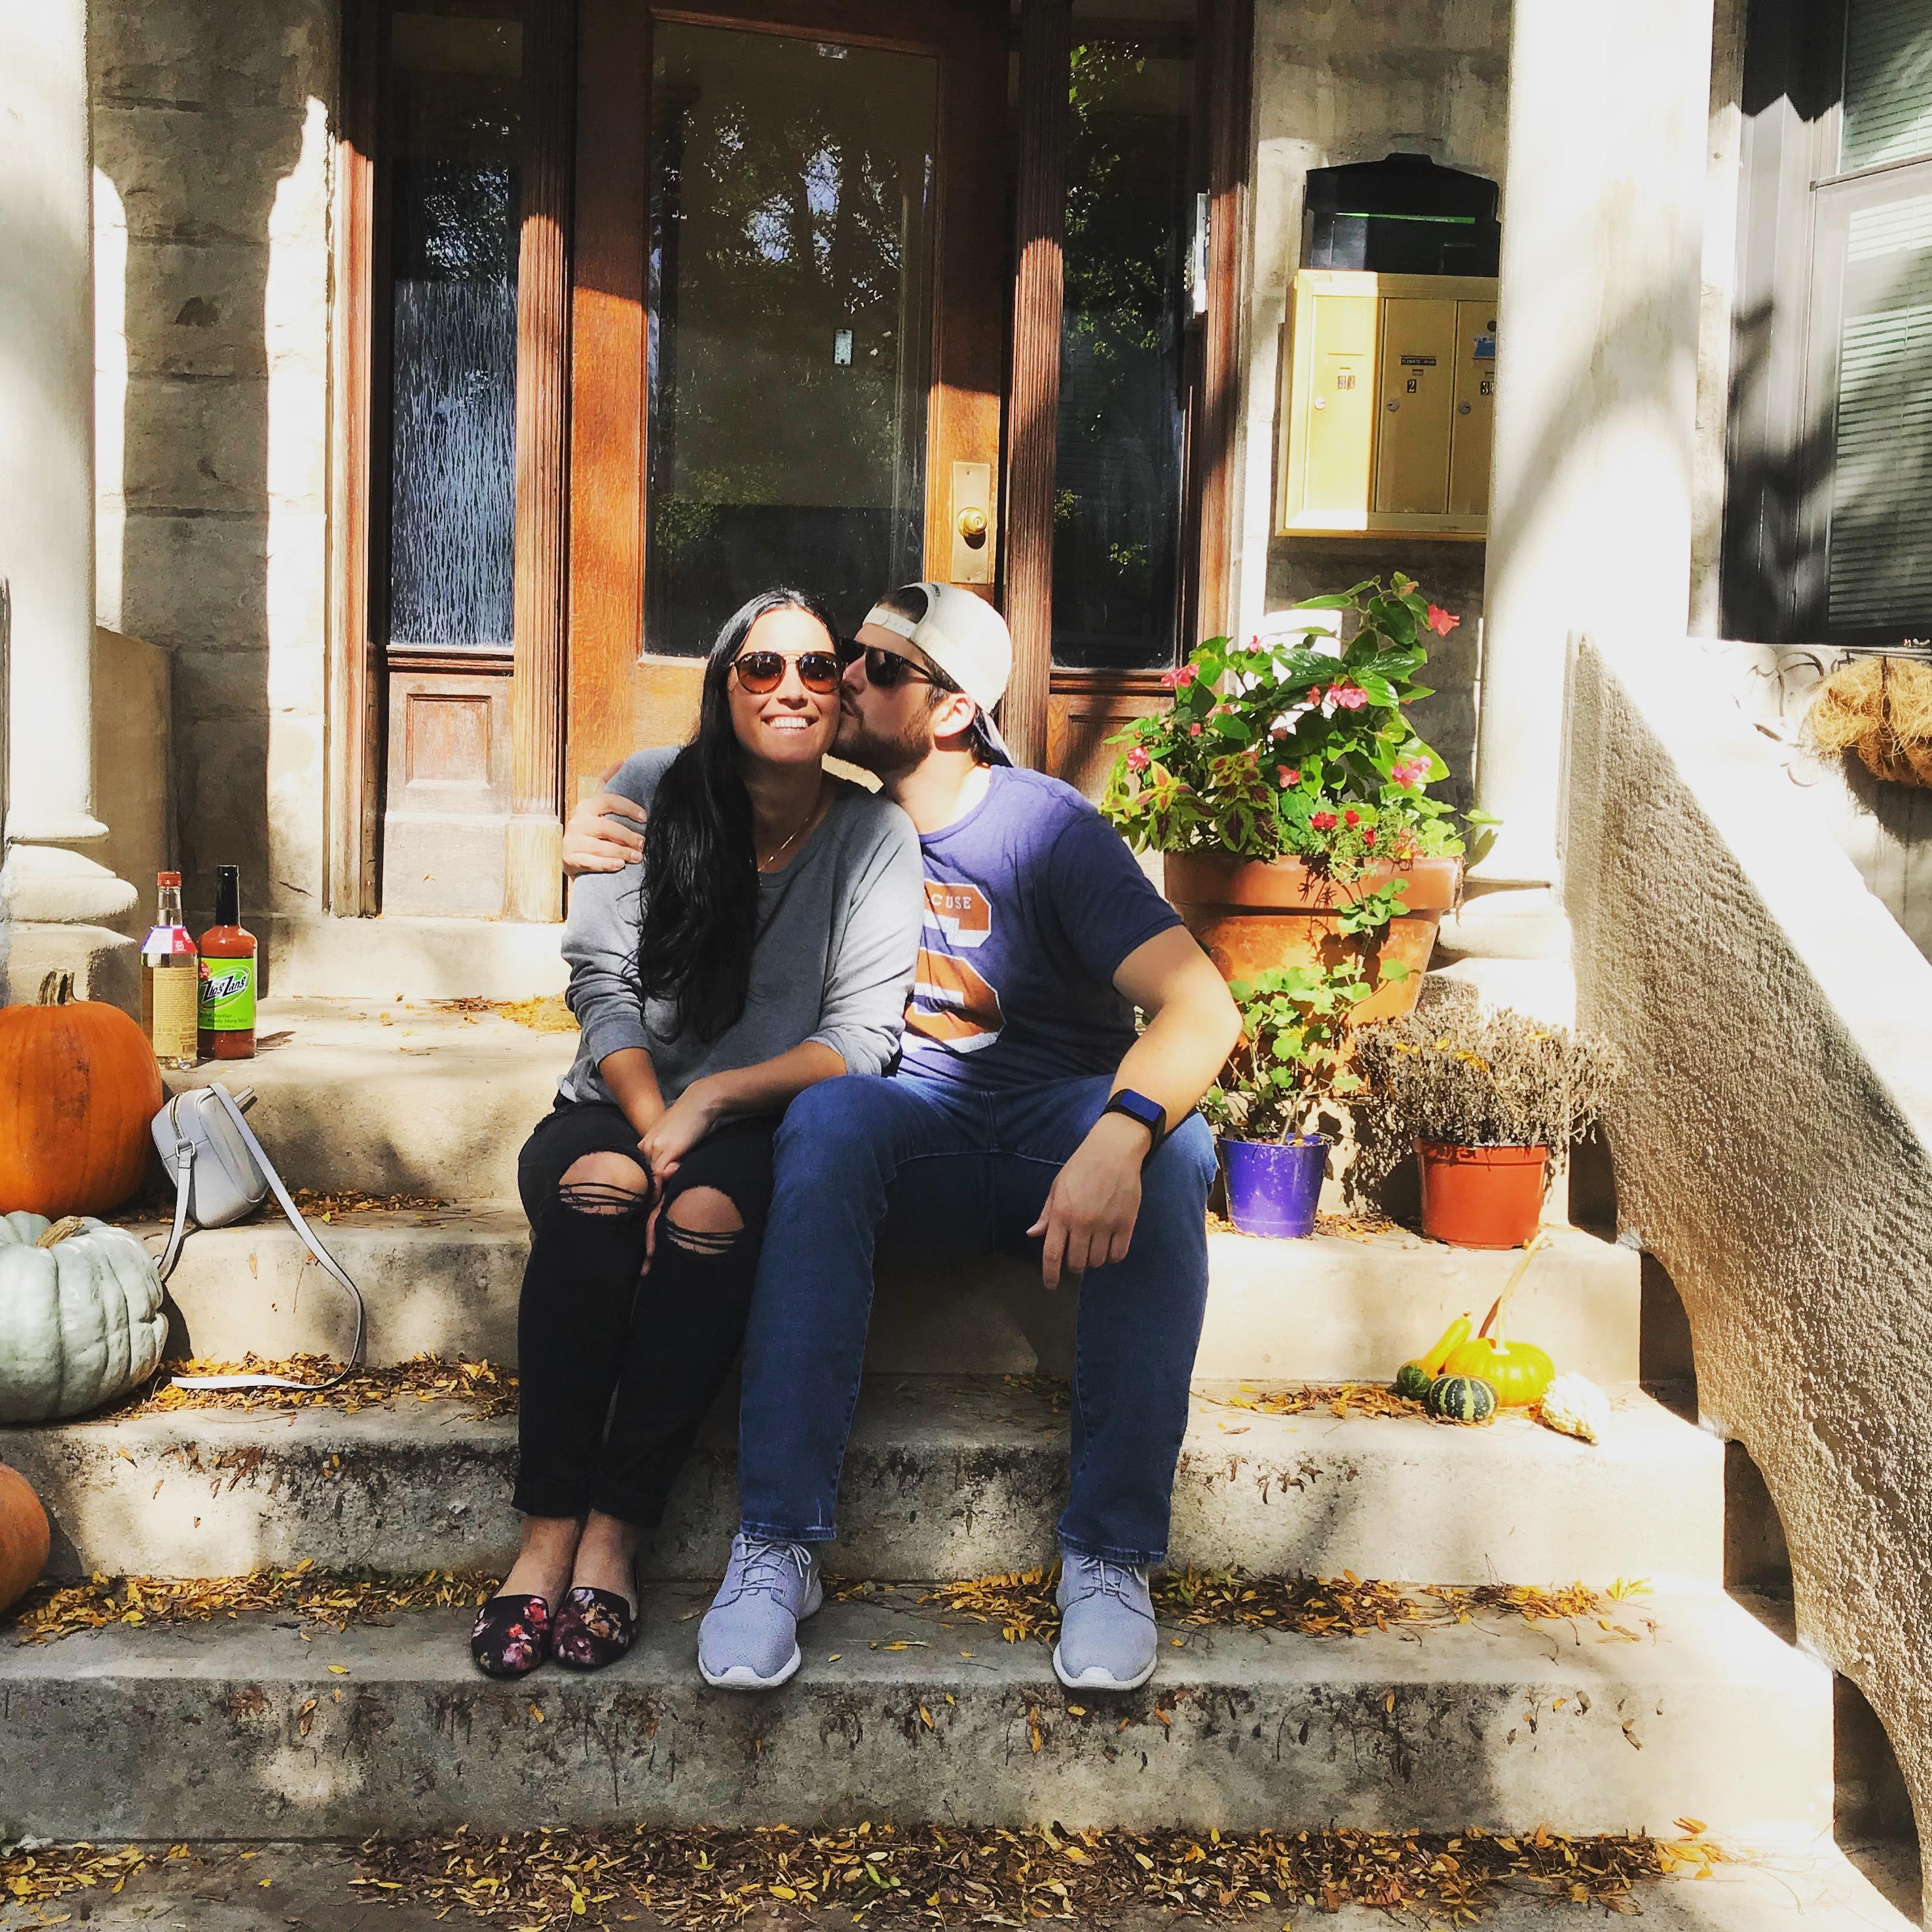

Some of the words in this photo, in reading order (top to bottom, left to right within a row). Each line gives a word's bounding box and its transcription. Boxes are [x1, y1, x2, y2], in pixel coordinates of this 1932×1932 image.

[1408, 380, 1415, 392] 2
[927, 893, 972, 910] CUSE
[202, 980, 225, 1002] Zing
[221, 975, 247, 997] Zang
